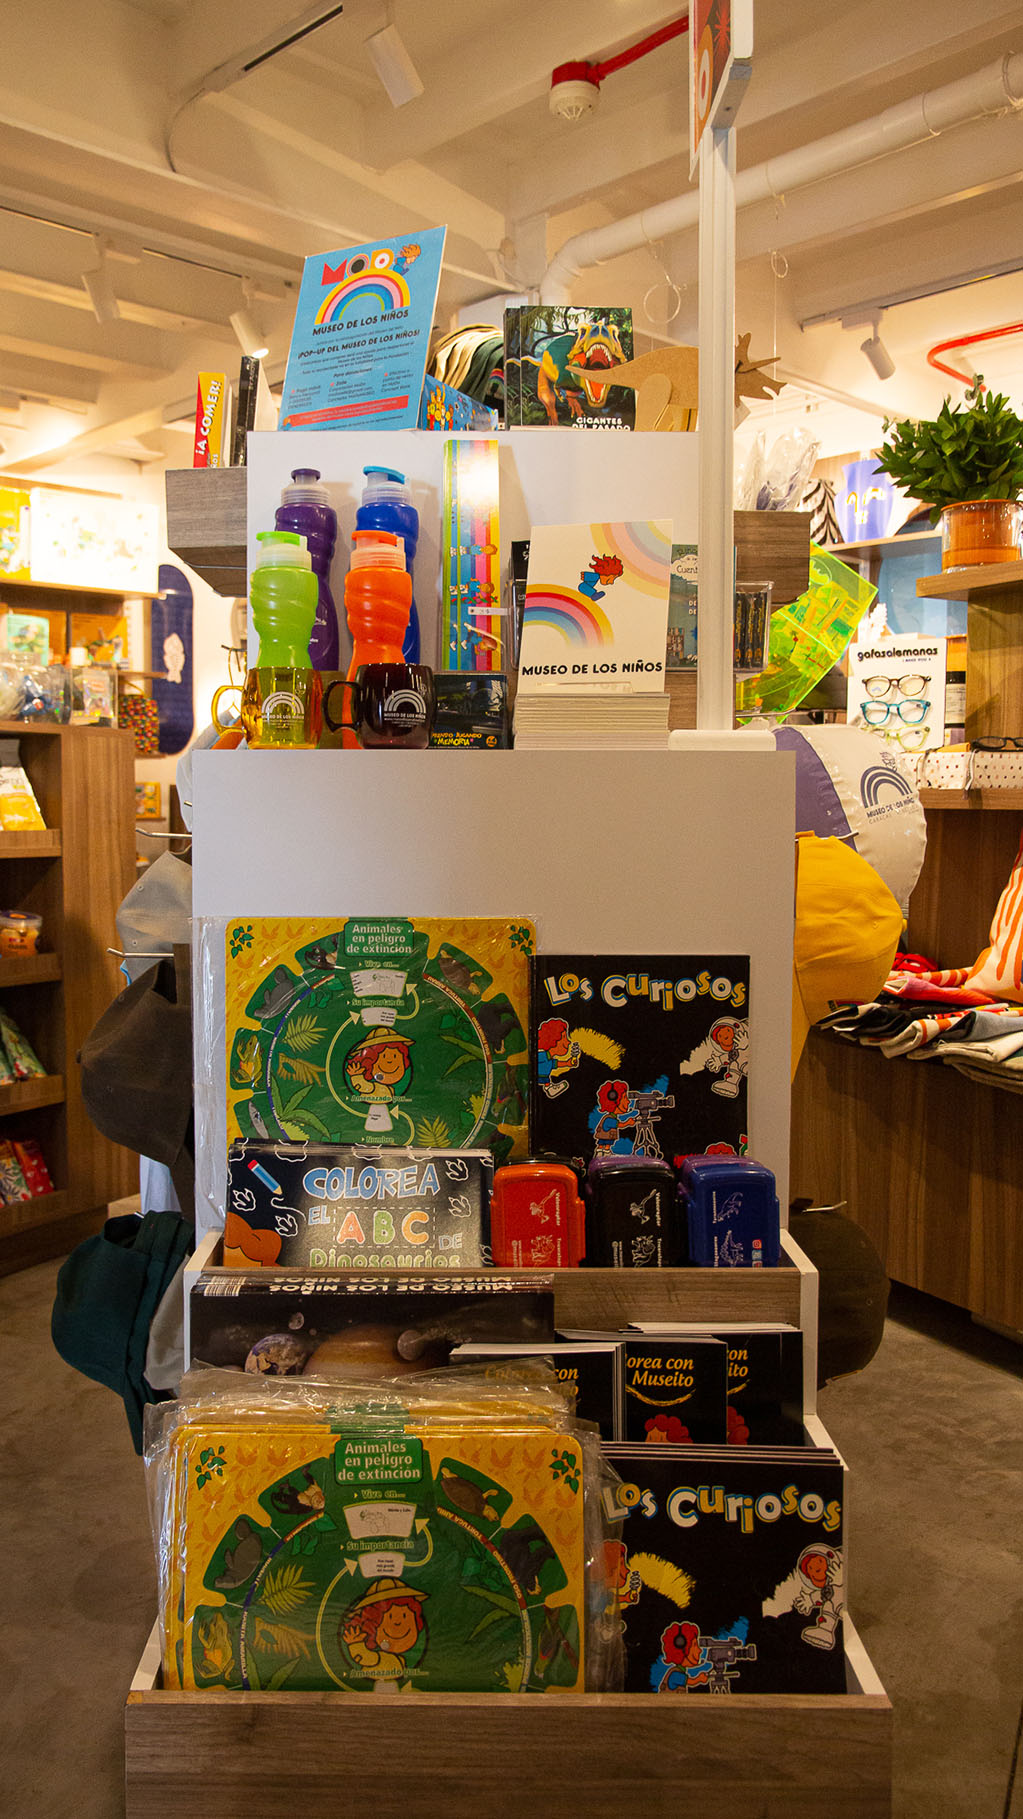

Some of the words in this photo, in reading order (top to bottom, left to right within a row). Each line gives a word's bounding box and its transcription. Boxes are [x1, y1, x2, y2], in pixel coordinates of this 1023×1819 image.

[312, 322, 344, 336] MUSEO
[346, 319, 358, 328] DE
[360, 316, 378, 326] LOS
[380, 310, 409, 322] NIÑOS
[298, 346, 326, 359] ¡POP-UP
[342, 340, 367, 351] MUSEO
[379, 334, 393, 343] LOS
[395, 329, 420, 339] NIÑOS!
[200, 380, 222, 437] COMER!
[195, 440, 208, 455] ¡A
[522, 664, 568, 676] MUSEO
[571, 664, 588, 674] DE
[593, 663, 618, 674] LOS
[622, 659, 663, 672] NIÑOS
[437, 738, 470, 746] MEMORIA
[352, 924, 402, 933] Animales
[368, 933, 406, 945] peligro
[347, 944, 360, 953] de
[303, 1163, 440, 1200] COLOREA
[308, 1205, 330, 1225] EL
[438, 1233, 463, 1250] DE
[309, 1248, 462, 1267] Dinosaurios
[269, 1285, 338, 1295] NIÑOS
[626, 1357, 662, 1368] orea
[666, 1358, 694, 1370] con
[632, 1370, 694, 1387] Museito
[345, 1441, 406, 1454] Animales
[345, 1457, 360, 1466] en
[365, 1453, 412, 1468] peligro
[338, 1469, 354, 1480] de
[358, 1466, 420, 1480] extinción
[361, 1489, 382, 1499] Vive
[454, 1516, 482, 1540] TORTUGA
[346, 1541, 359, 1550] Su
[360, 1540, 414, 1552] importancia
[513, 1584, 522, 1599] OSO
